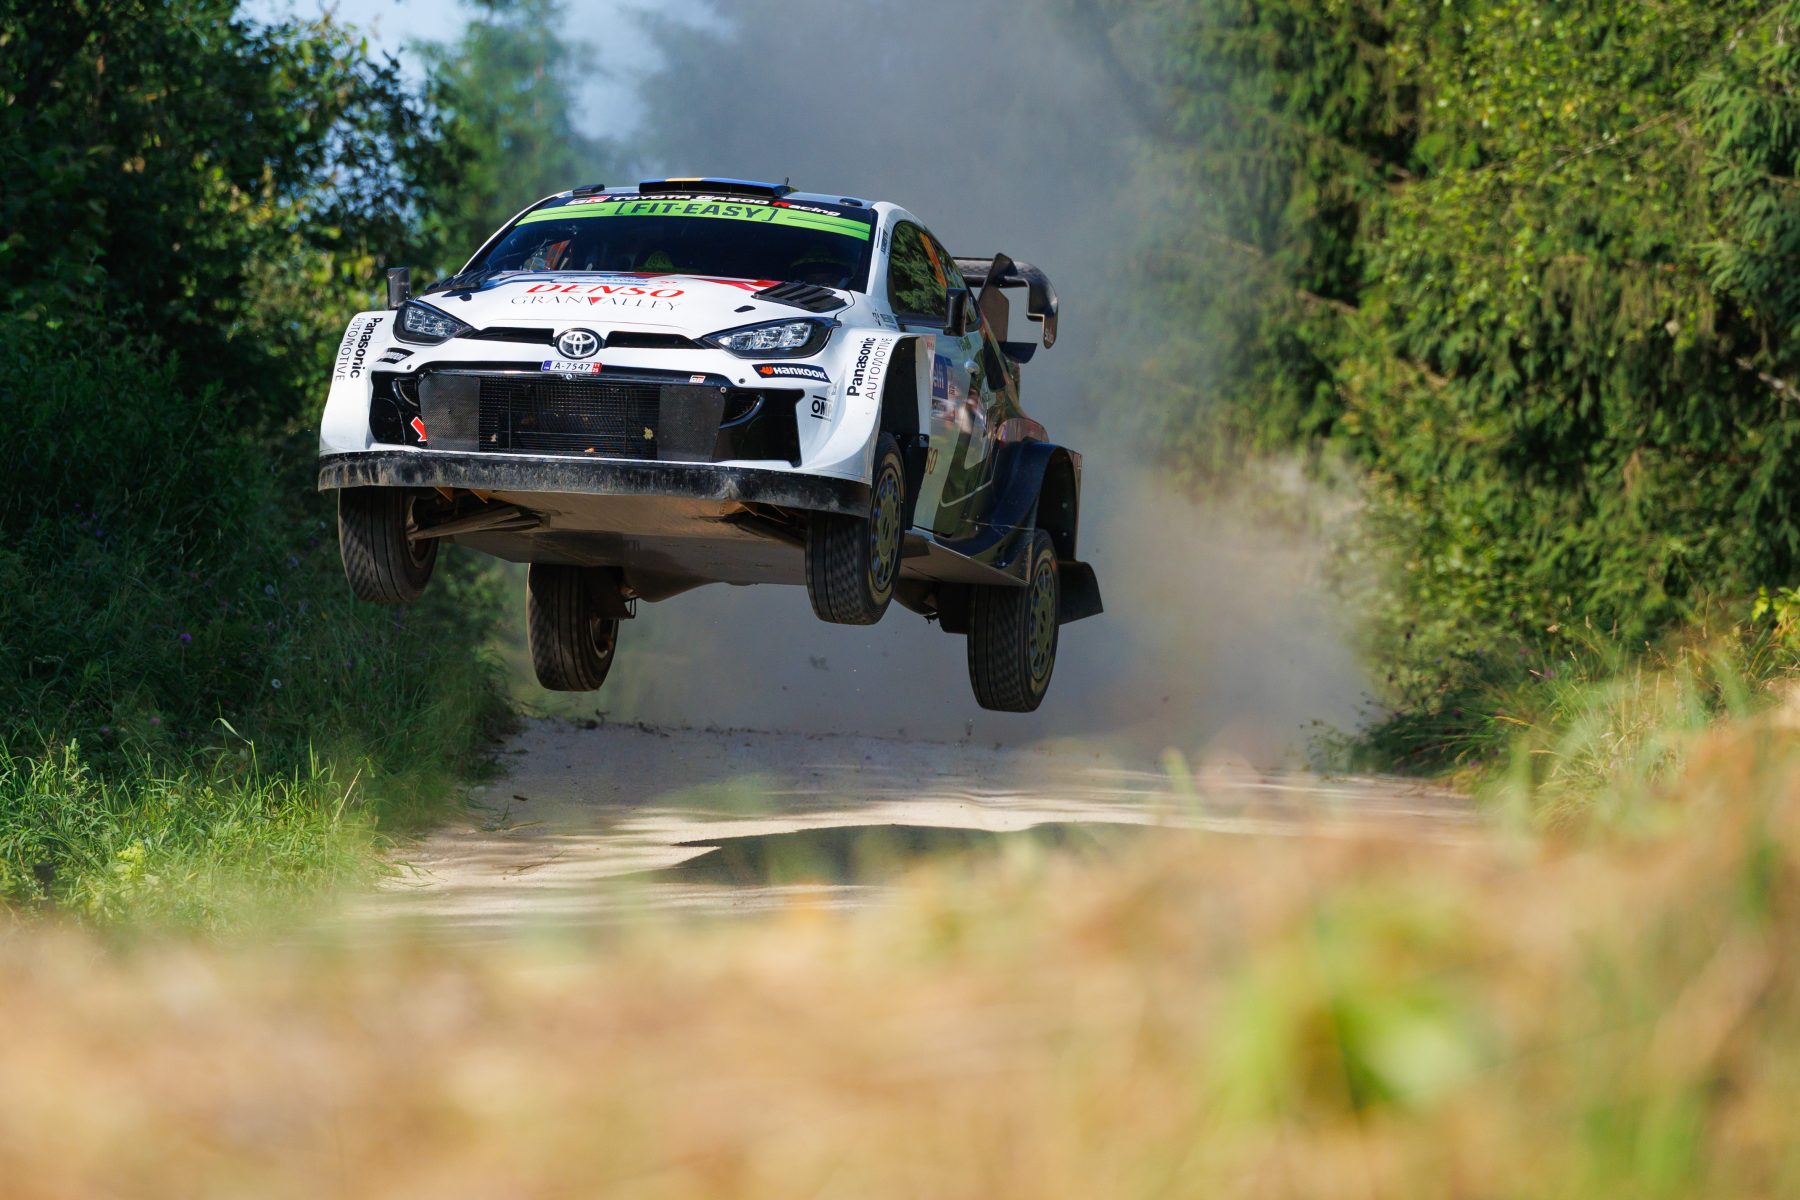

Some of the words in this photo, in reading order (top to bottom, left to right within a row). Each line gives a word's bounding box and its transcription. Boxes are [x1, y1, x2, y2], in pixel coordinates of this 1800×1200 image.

[526, 284, 685, 298] DENSO
[335, 317, 366, 381] AUTOMOTIVE
[350, 317, 384, 379] Panasonic
[554, 362, 591, 371] A-7547
[846, 337, 877, 397] Panasonic
[865, 338, 893, 400] AUTOMOTIVE
